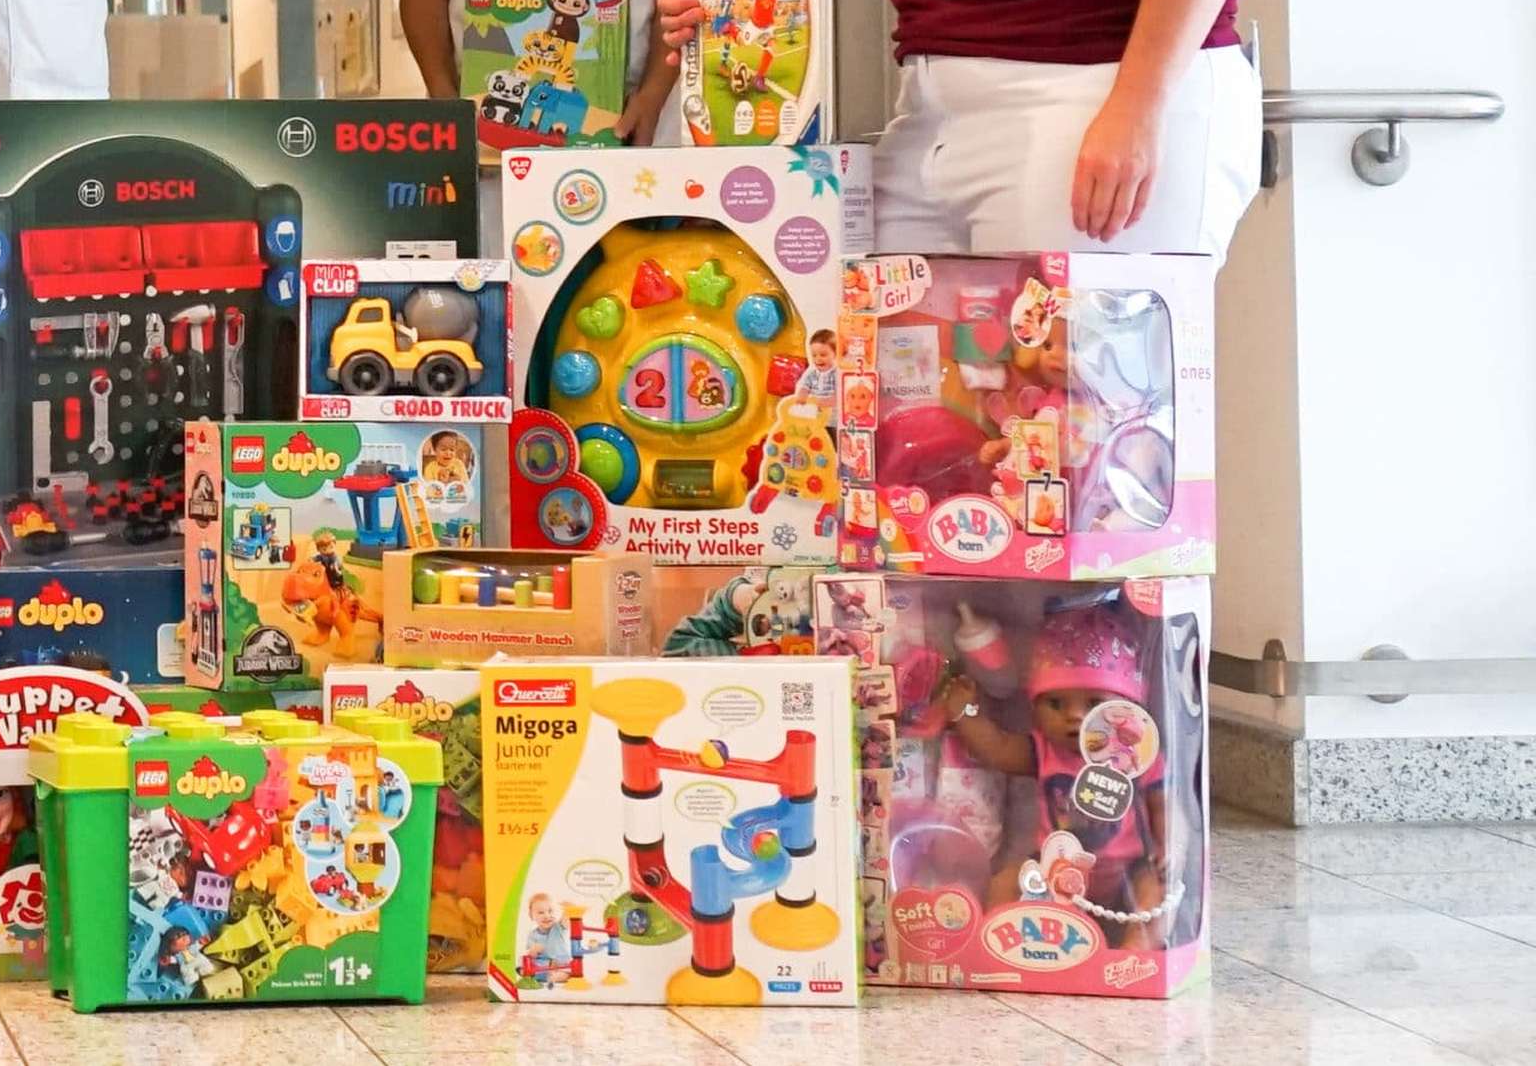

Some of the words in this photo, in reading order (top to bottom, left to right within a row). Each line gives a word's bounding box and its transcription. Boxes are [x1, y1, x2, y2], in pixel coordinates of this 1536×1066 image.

[335, 121, 458, 153] BOSCH
[116, 180, 195, 202] BOSCH
[388, 175, 457, 209] mini
[875, 259, 925, 285] Little
[313, 280, 355, 294] CLUB
[885, 287, 911, 308] Girl
[1180, 366, 1212, 381] ones
[635, 370, 666, 409] 2
[394, 400, 444, 417] ROAD
[450, 401, 505, 418] TRUCK
[234, 448, 263, 463] LEGO
[272, 447, 341, 476] duplo
[629, 518, 655, 538] My
[664, 518, 702, 535] First
[708, 518, 759, 538] Steps
[936, 508, 1005, 545] BABY
[626, 539, 692, 559] Activity
[698, 539, 765, 556] Walker
[958, 540, 984, 552] born
[18, 597, 104, 631] duplo
[430, 630, 478, 643] Wooden
[481, 632, 533, 645] Hammer
[536, 633, 573, 646] Bench
[334, 695, 365, 710] LEGO
[377, 694, 453, 727] duplo
[496, 714, 578, 739] Migoga
[496, 741, 552, 762] Junior
[136, 770, 167, 786] LEGO
[176, 770, 246, 799] duplo
[1087, 771, 1128, 794] NEW!
[895, 904, 933, 920] Soft
[991, 916, 1089, 954] BABY
[1021, 946, 1059, 961] born
[777, 966, 792, 977] 22
[811, 983, 842, 992] STEAM
